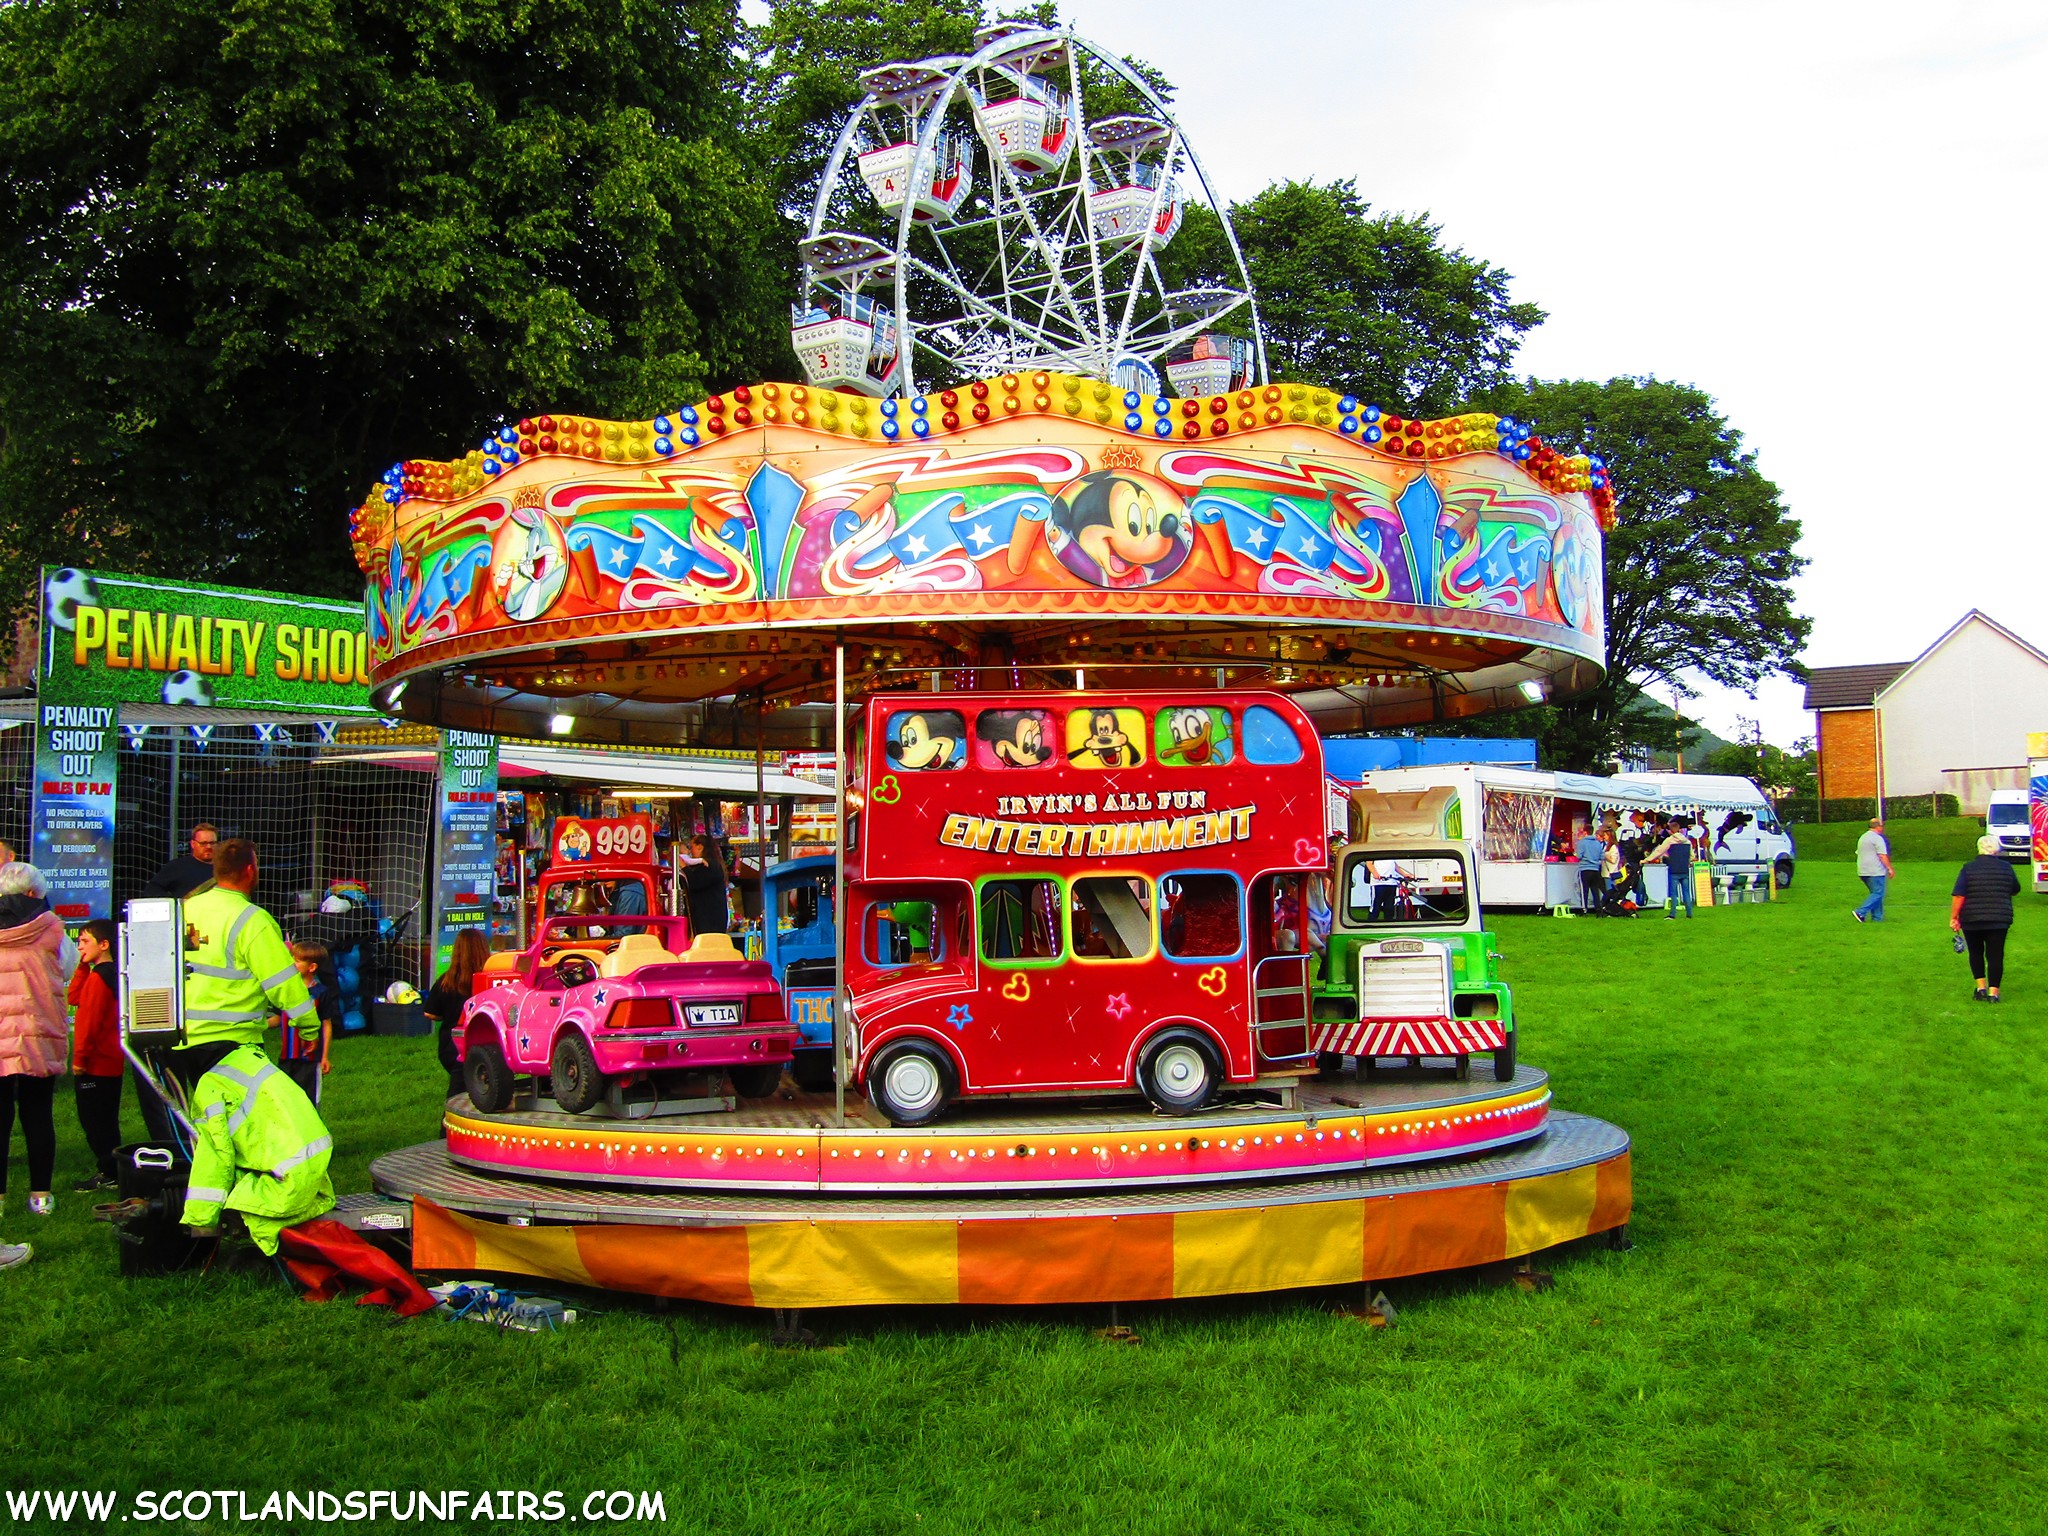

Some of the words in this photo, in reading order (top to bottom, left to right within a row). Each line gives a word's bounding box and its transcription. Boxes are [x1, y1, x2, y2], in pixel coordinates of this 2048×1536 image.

[999, 132, 1008, 146] 5
[885, 178, 895, 192] 4
[1111, 216, 1119, 229] 1
[818, 354, 828, 369] 3
[1190, 385, 1201, 397] 2
[73, 604, 266, 678] PENALTY
[43, 705, 114, 728] PENALTY
[51, 730, 106, 752] SHOOT
[449, 729, 495, 747] PENALTY
[62, 754, 95, 776] OUT
[454, 749, 490, 767] SHOOT
[461, 769, 483, 787] OUT
[996, 791, 1098, 816] IRVIN'S
[1102, 791, 1152, 812] ALL
[1156, 790, 1207, 809] FUN
[46, 808, 57, 818] NO
[57, 808, 85, 818] PASSING
[85, 809, 105, 818] BALLS
[46, 820, 56, 829] TO
[56, 820, 76, 830] OTHER
[76, 821, 103, 830] PLAYERS
[939, 804, 1257, 858] ENTERTAINMENT
[596, 823, 648, 856] 999
[51, 844, 62, 853] NO
[62, 844, 97, 853] REBOUNDS
[60, 868, 78, 877] MUST
[79, 868, 87, 877] BE
[88, 868, 108, 877] TAKEN
[54, 880, 66, 889] THE
[67, 880, 94, 889] MARKED
[94, 880, 111, 889] SPOT
[451, 913, 464, 922] BALL
[472, 912, 485, 921] HOLE
[709, 1008, 737, 1022] TIA
